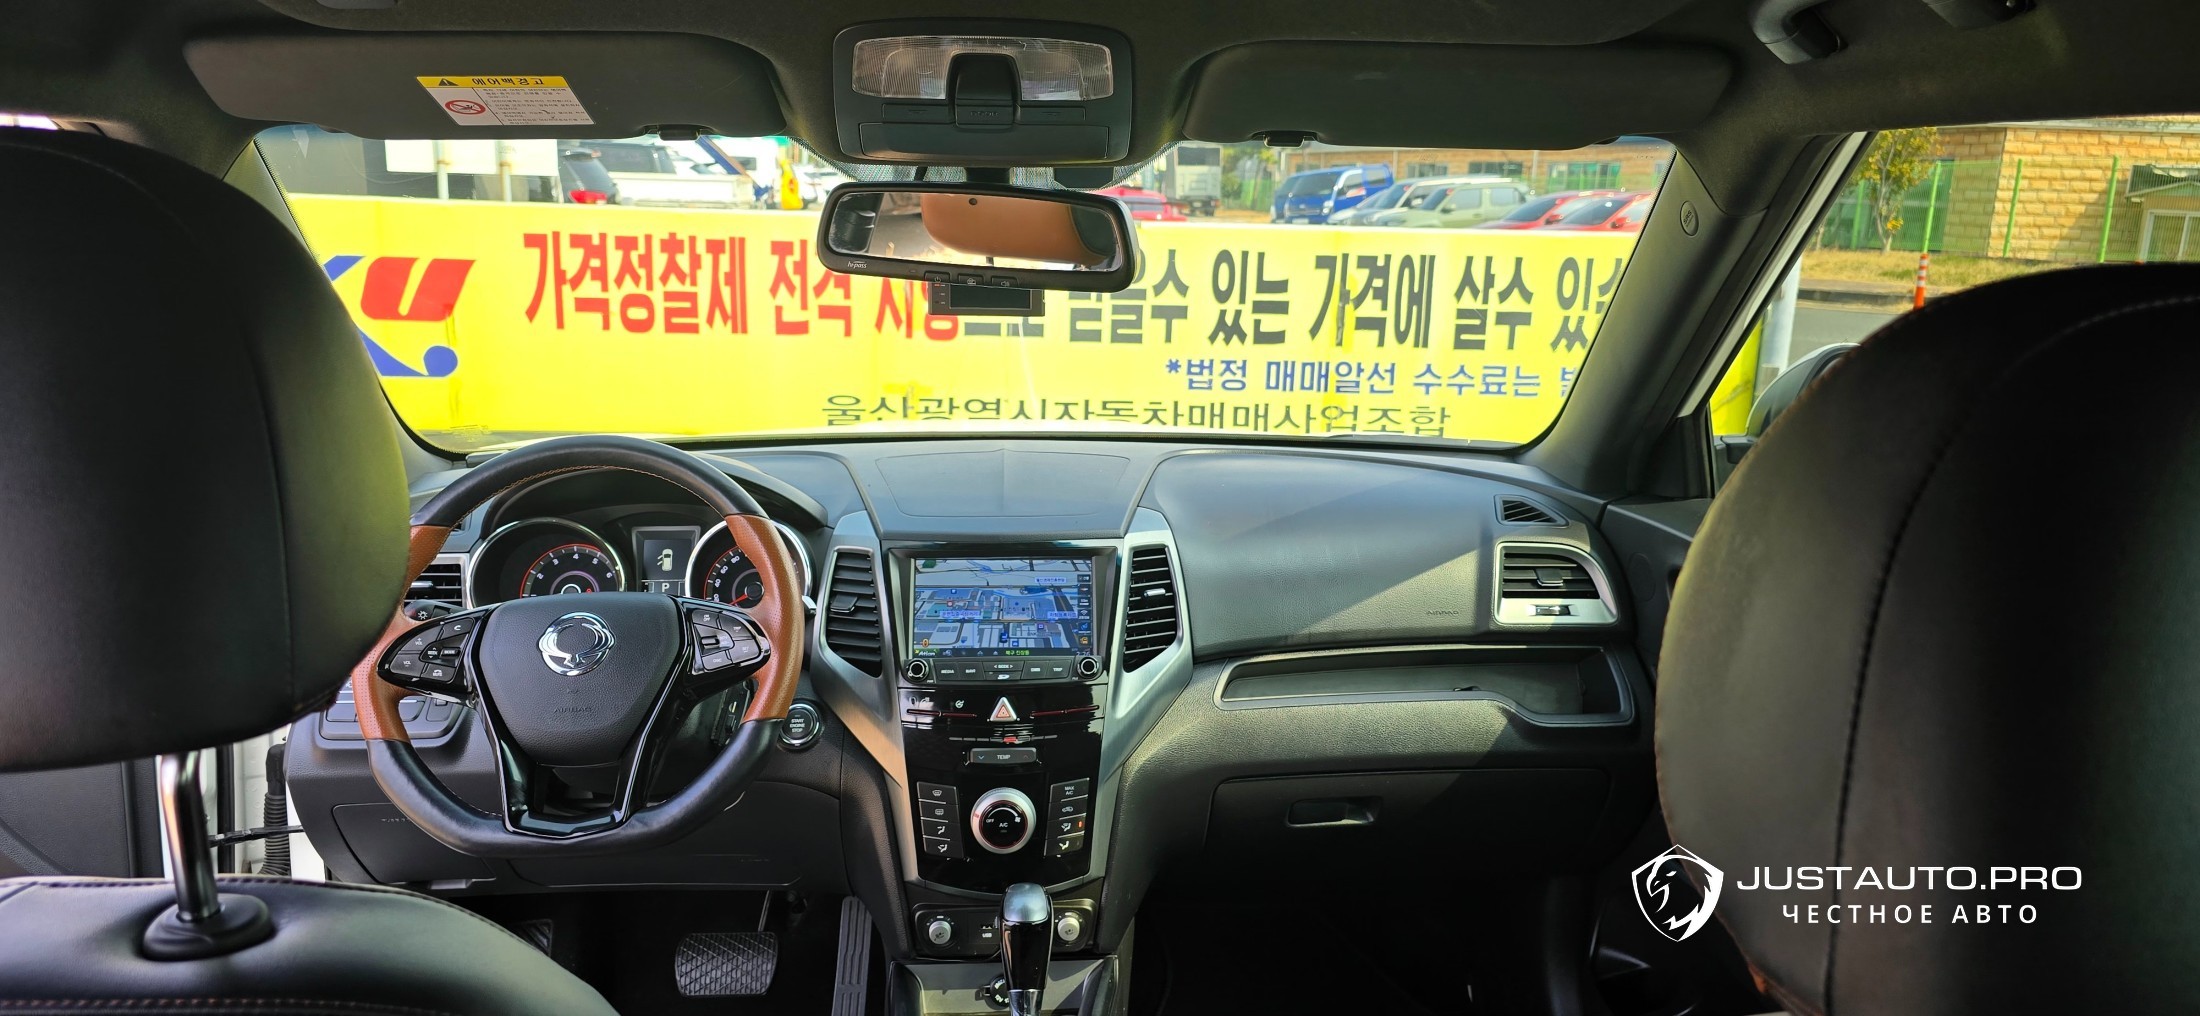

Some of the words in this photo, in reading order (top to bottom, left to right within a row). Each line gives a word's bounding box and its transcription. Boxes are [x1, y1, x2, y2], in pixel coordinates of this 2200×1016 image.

[523, 231, 748, 334] 가격정찰제
[769, 239, 853, 337] 전격
[1208, 249, 1289, 346] 있는
[1309, 252, 1436, 349] 가격에
[1454, 255, 1534, 350] 살수
[1265, 360, 1396, 394] 매매알선
[1412, 363, 1541, 397] 수수료는
[552, 558, 559, 566] 3
[592, 557, 599, 565] 5
[661, 582, 670, 593] P
